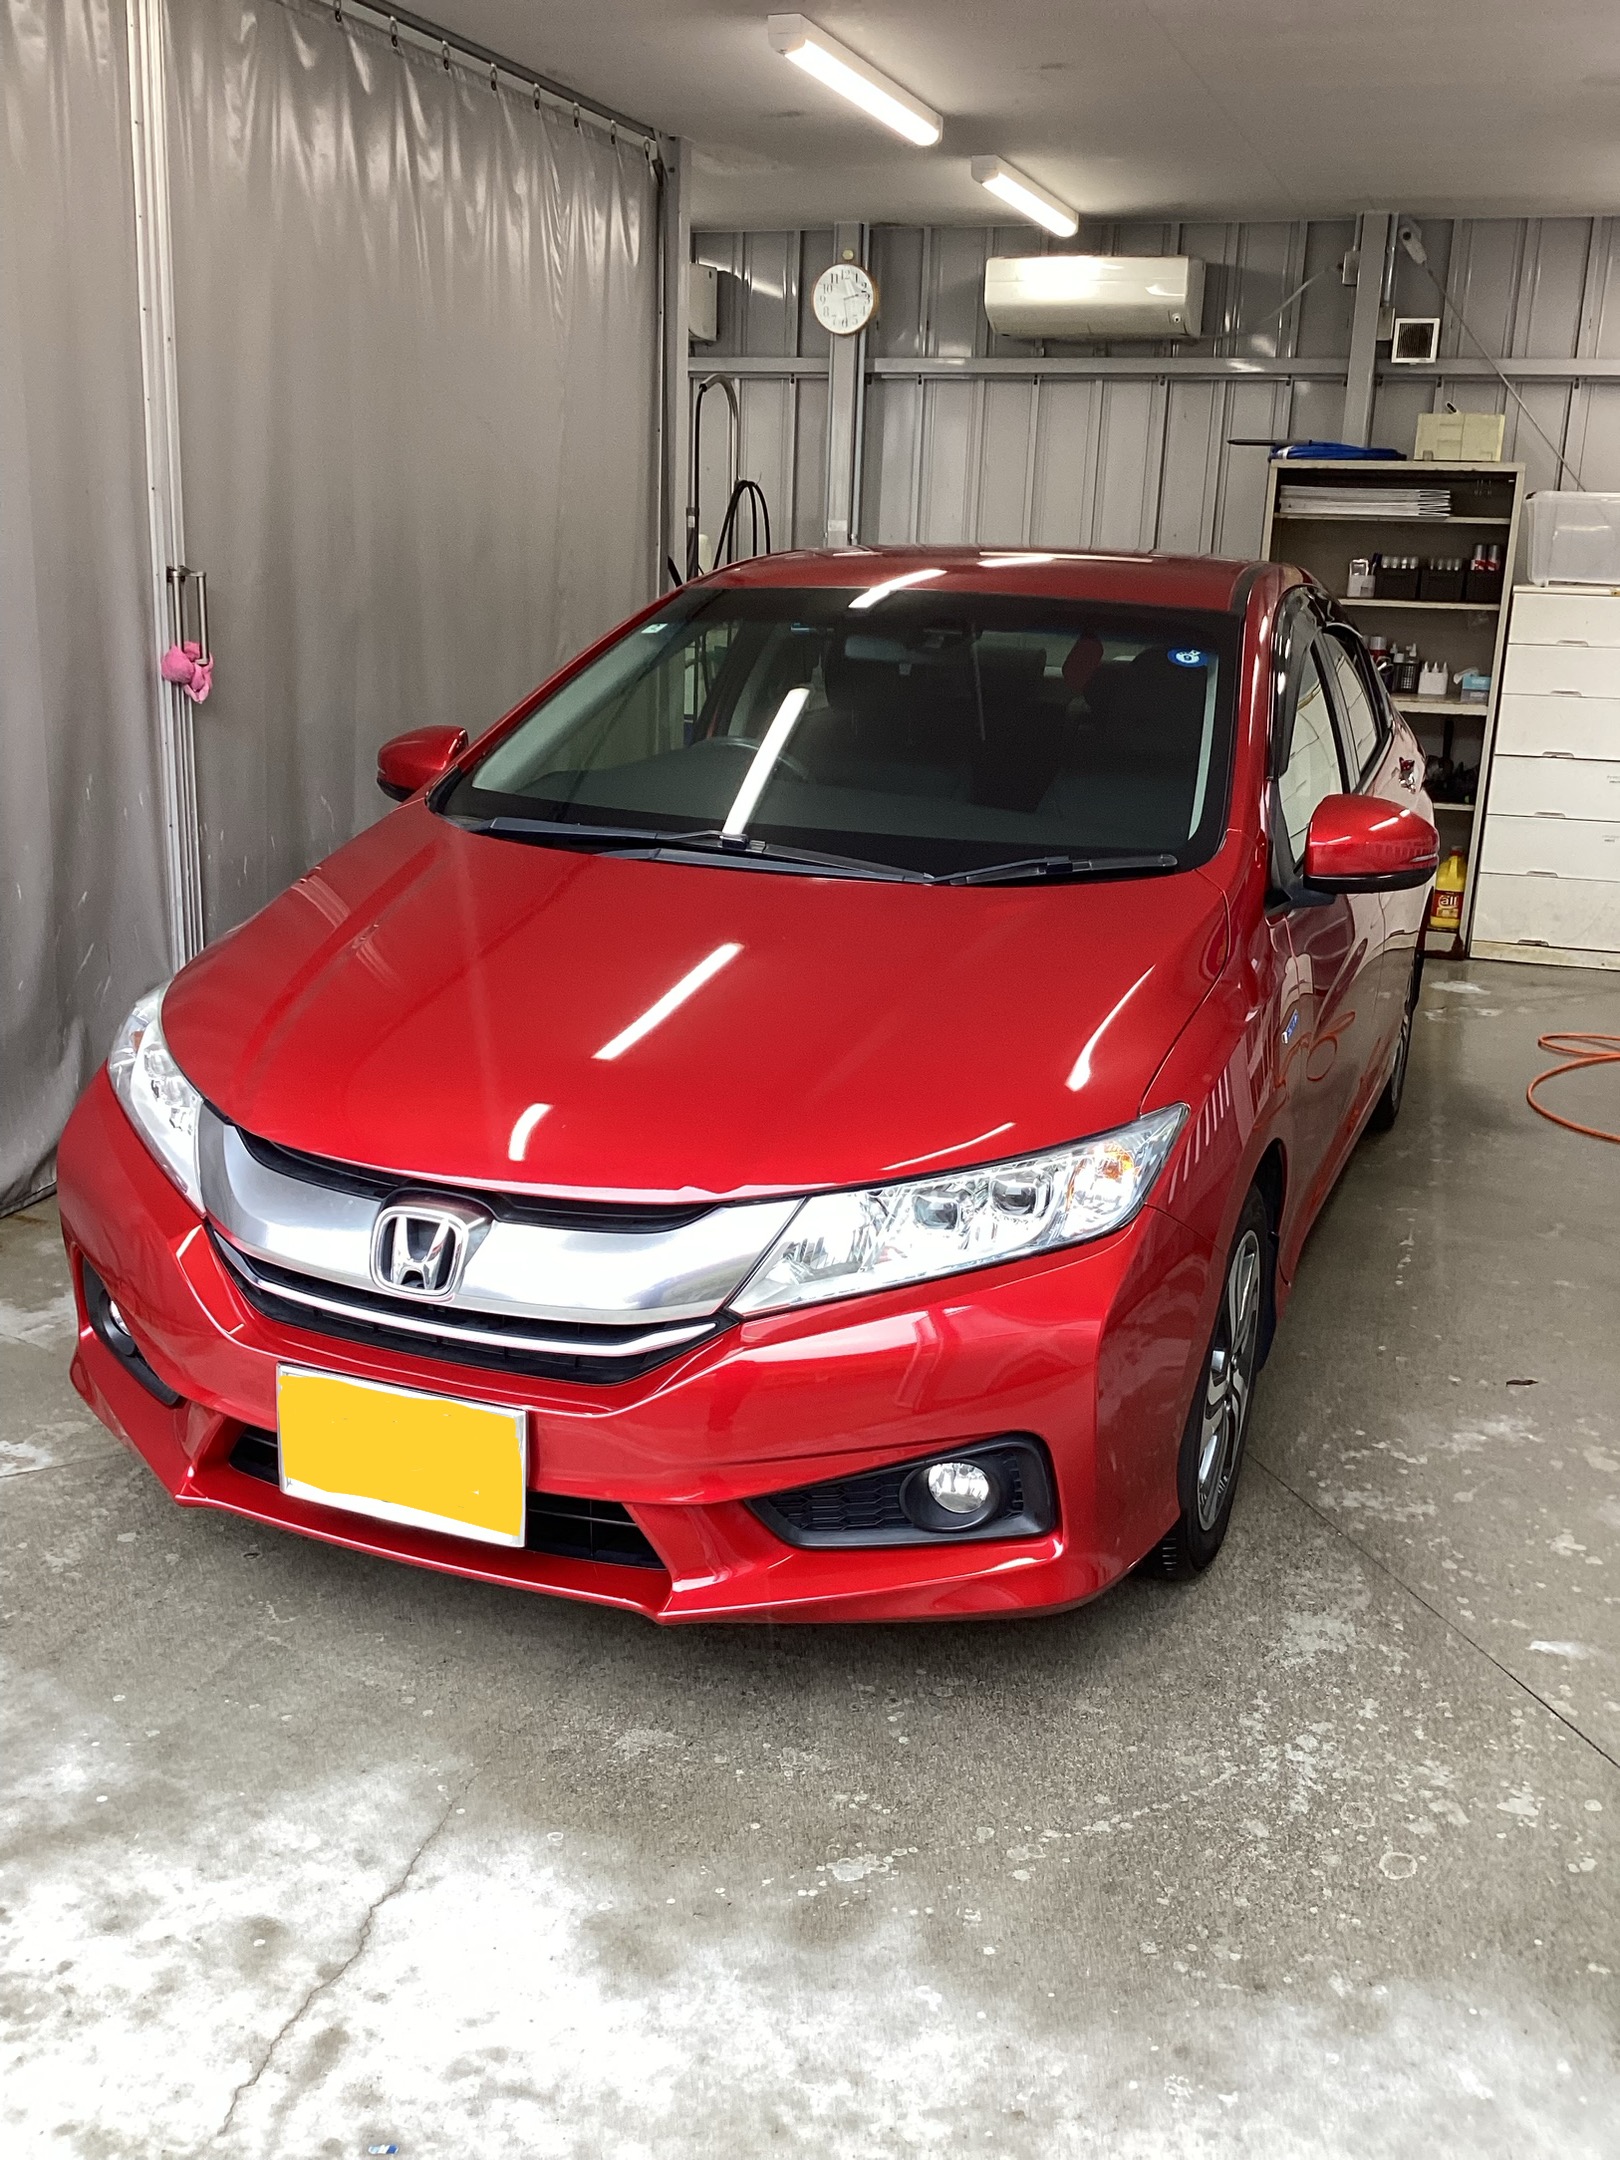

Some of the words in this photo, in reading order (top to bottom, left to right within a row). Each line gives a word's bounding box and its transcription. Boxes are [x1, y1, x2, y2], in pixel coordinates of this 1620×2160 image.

[830, 272, 839, 284] 11
[841, 269, 851, 280] 12
[823, 283, 833, 294] 10
[861, 281, 868, 293] 2
[819, 295, 826, 305] 9
[823, 305, 830, 317] 8
[841, 317, 848, 329] 6
[391, 1215, 449, 1290] H
